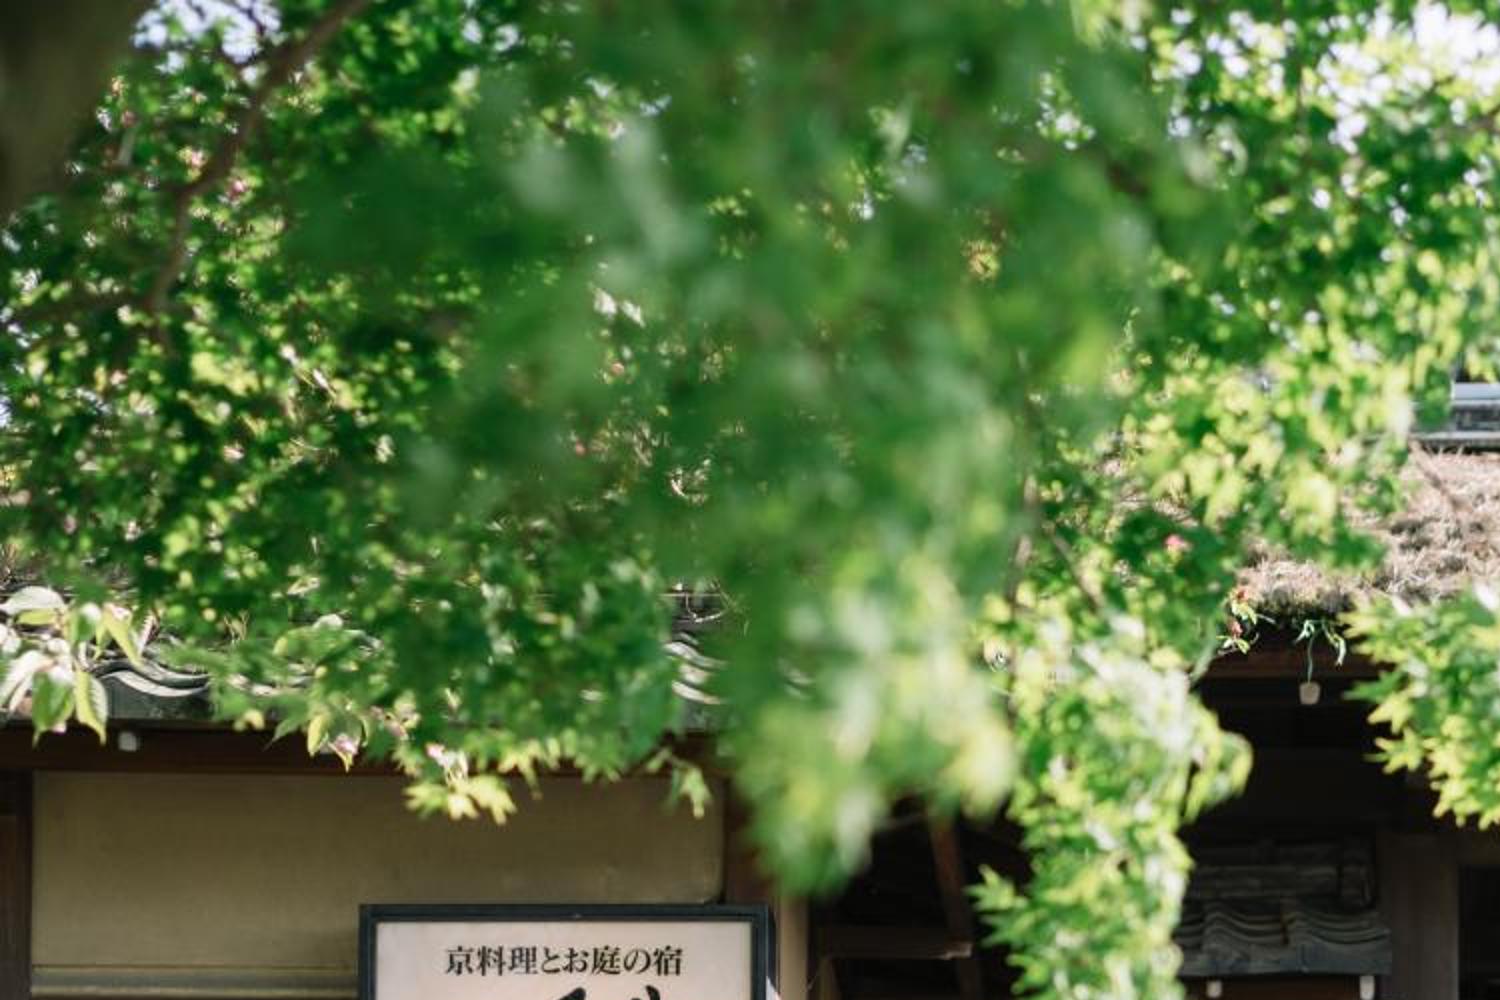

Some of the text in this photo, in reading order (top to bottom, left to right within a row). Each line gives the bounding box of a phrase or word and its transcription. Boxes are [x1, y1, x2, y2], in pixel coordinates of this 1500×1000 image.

[446, 946, 684, 976] 京料理とお庭の宿
